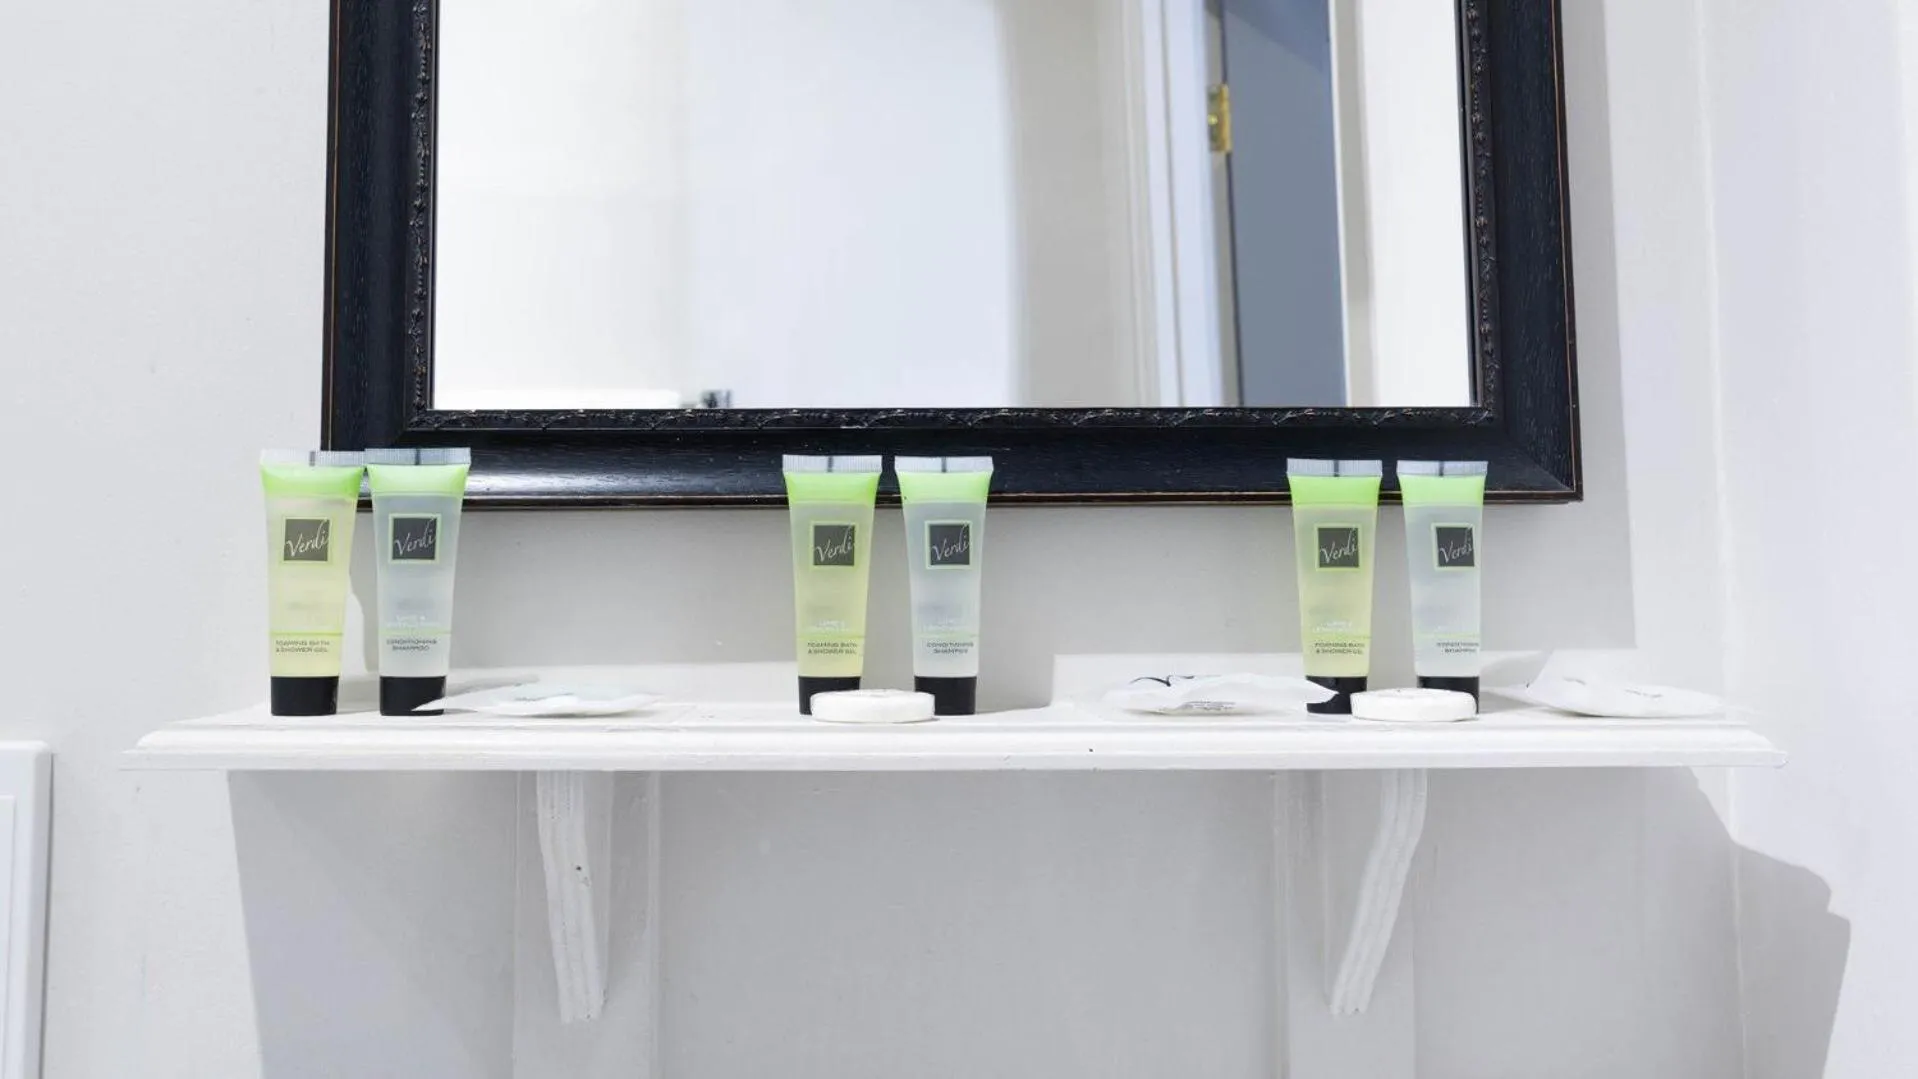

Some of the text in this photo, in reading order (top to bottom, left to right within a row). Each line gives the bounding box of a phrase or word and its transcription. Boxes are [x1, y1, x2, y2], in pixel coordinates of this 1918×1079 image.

[285, 519, 329, 557] Verdi
[394, 516, 437, 556] Verdi
[816, 524, 854, 562] Verdi
[932, 524, 970, 561] Verdi
[1320, 526, 1358, 564] Verdi
[1440, 525, 1473, 563] Verdi
